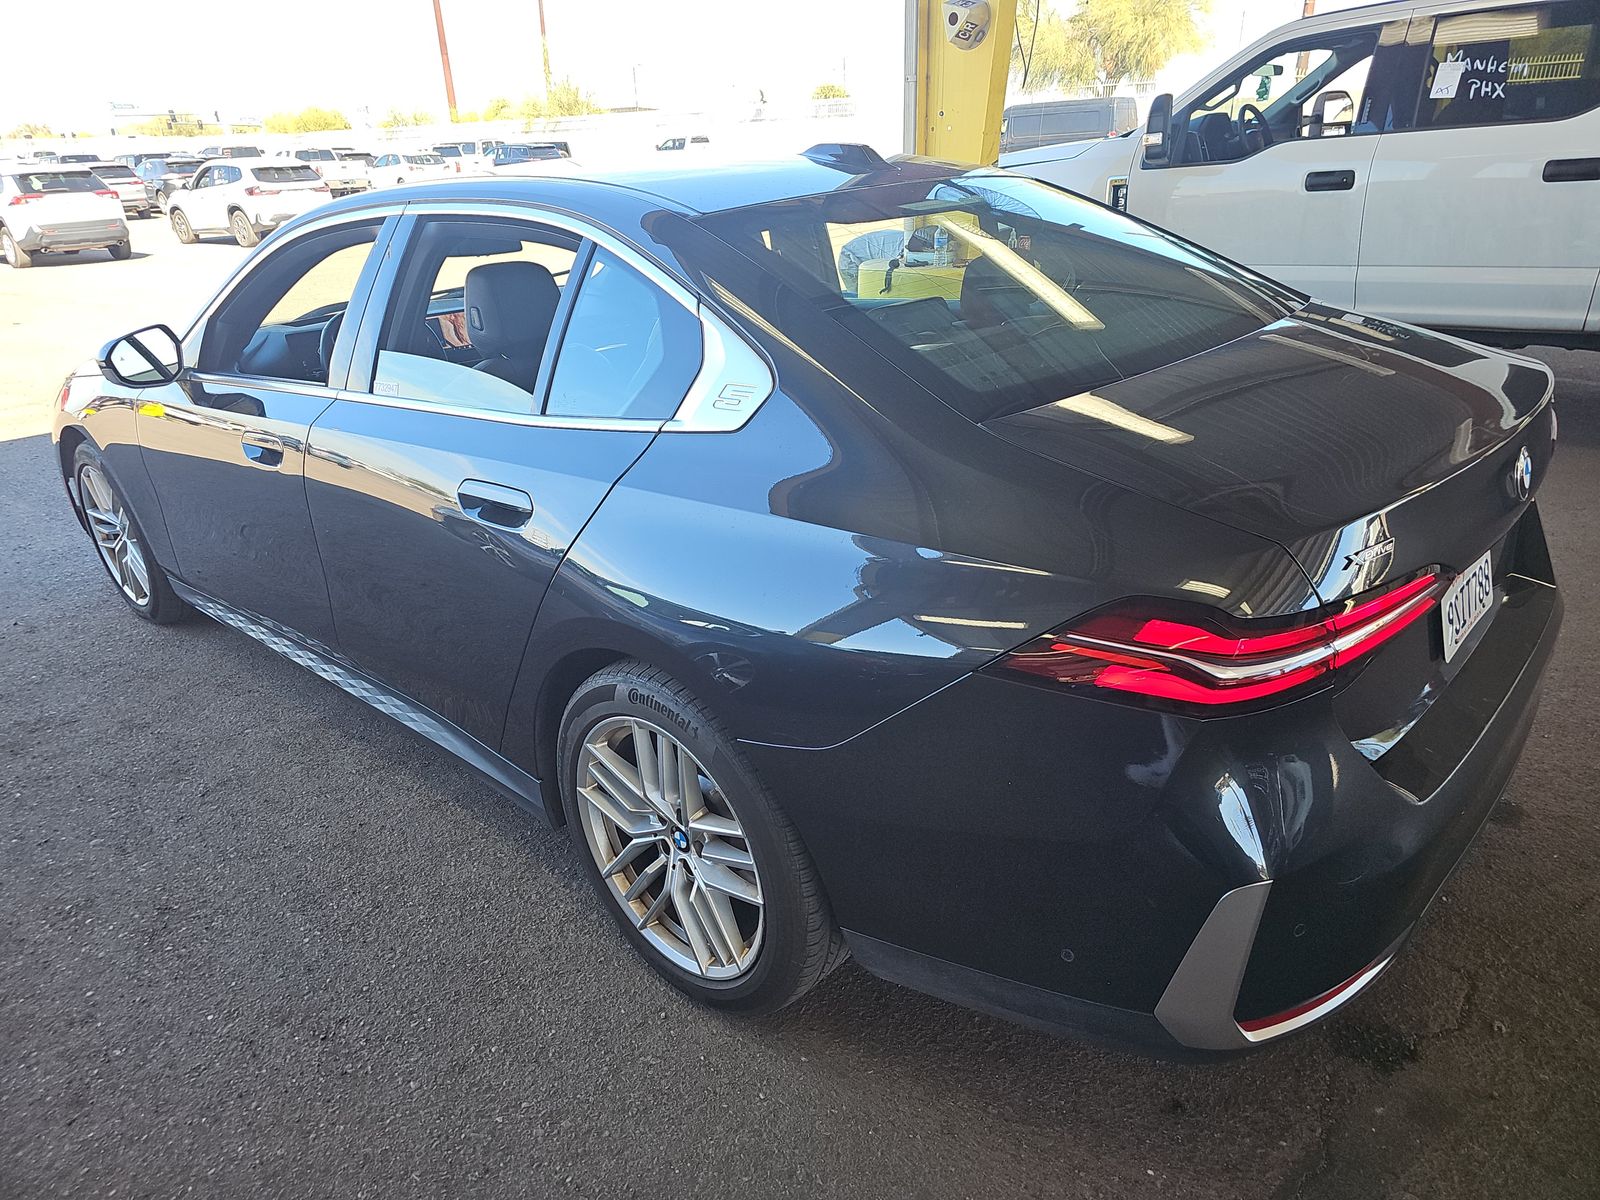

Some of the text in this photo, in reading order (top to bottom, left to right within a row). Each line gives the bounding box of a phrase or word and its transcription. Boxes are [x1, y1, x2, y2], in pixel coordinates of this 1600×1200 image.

[1468, 79, 1505, 99] PHX
[1447, 558, 1491, 647] 9SIT788
[627, 688, 692, 733] Continental
